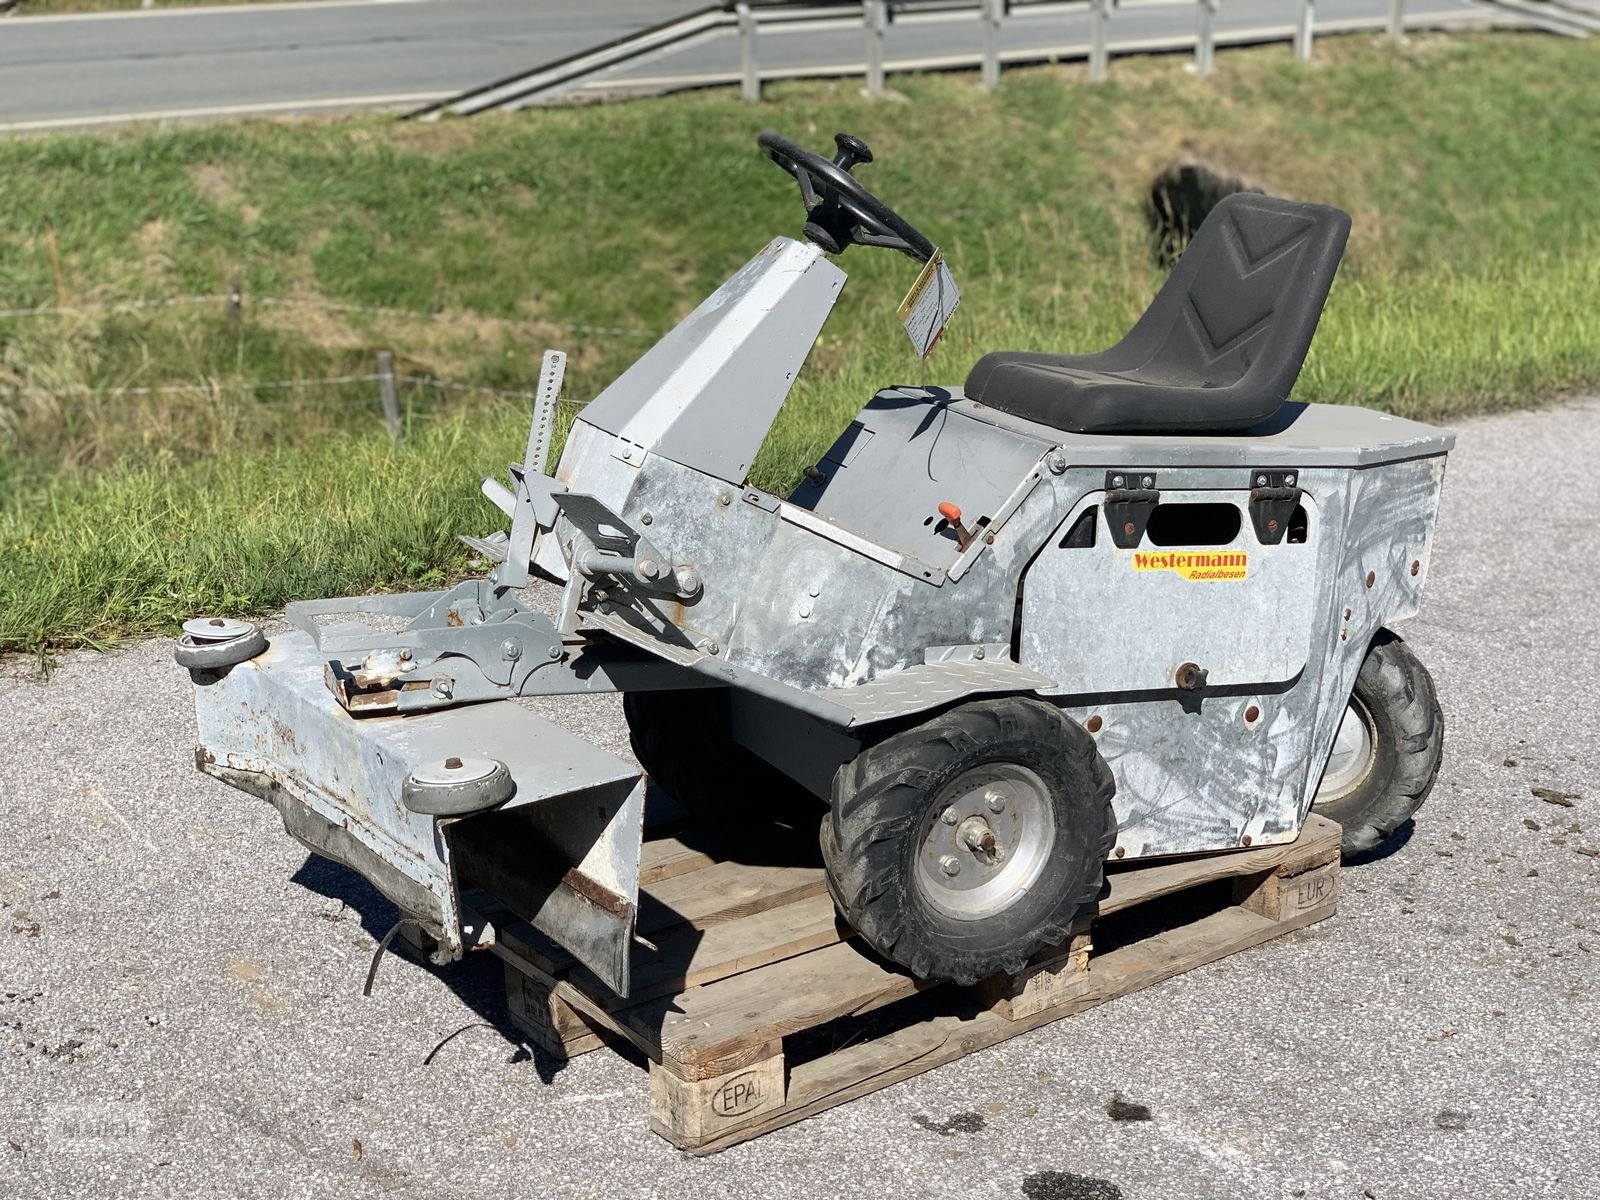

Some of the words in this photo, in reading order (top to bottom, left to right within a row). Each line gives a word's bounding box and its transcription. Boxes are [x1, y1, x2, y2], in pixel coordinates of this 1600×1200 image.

[1134, 553, 1248, 568] Westermann
[1189, 570, 1246, 580] Radialbesen
[1298, 879, 1325, 905] EUR
